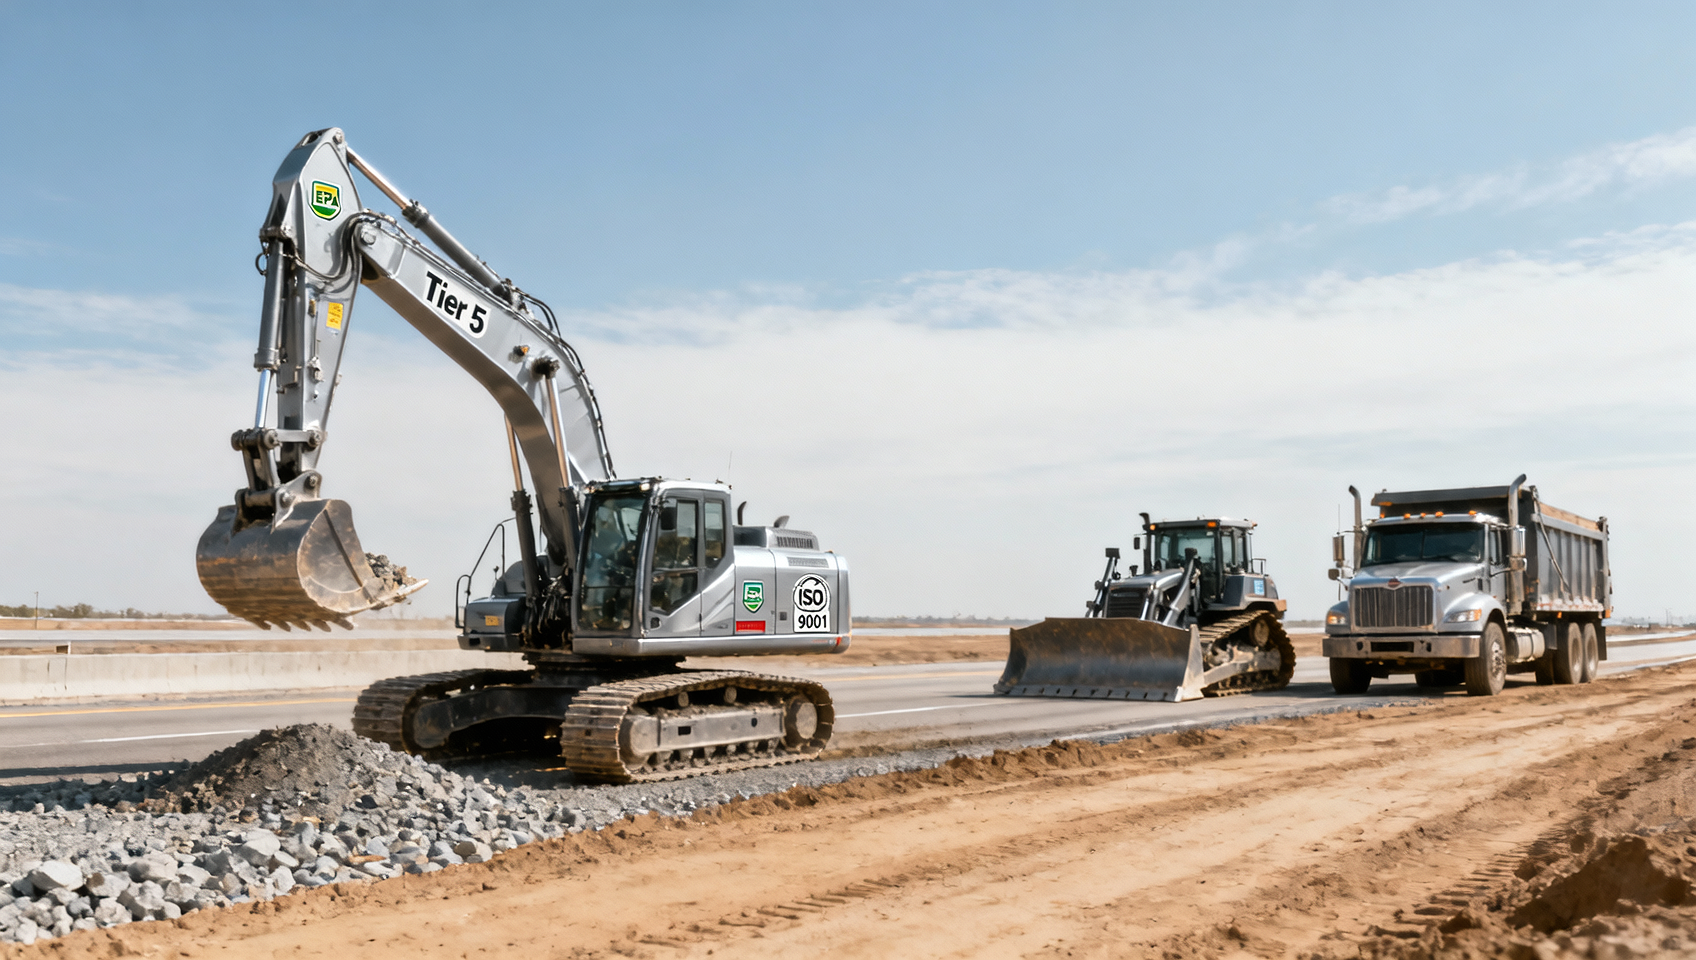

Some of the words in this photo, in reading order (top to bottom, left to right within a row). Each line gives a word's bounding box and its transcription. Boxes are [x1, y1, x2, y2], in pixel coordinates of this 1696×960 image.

[315, 190, 339, 207] EPA
[426, 271, 468, 320] Tier
[469, 304, 487, 334] 5
[798, 588, 824, 606] ISO
[798, 614, 827, 629] 9001
